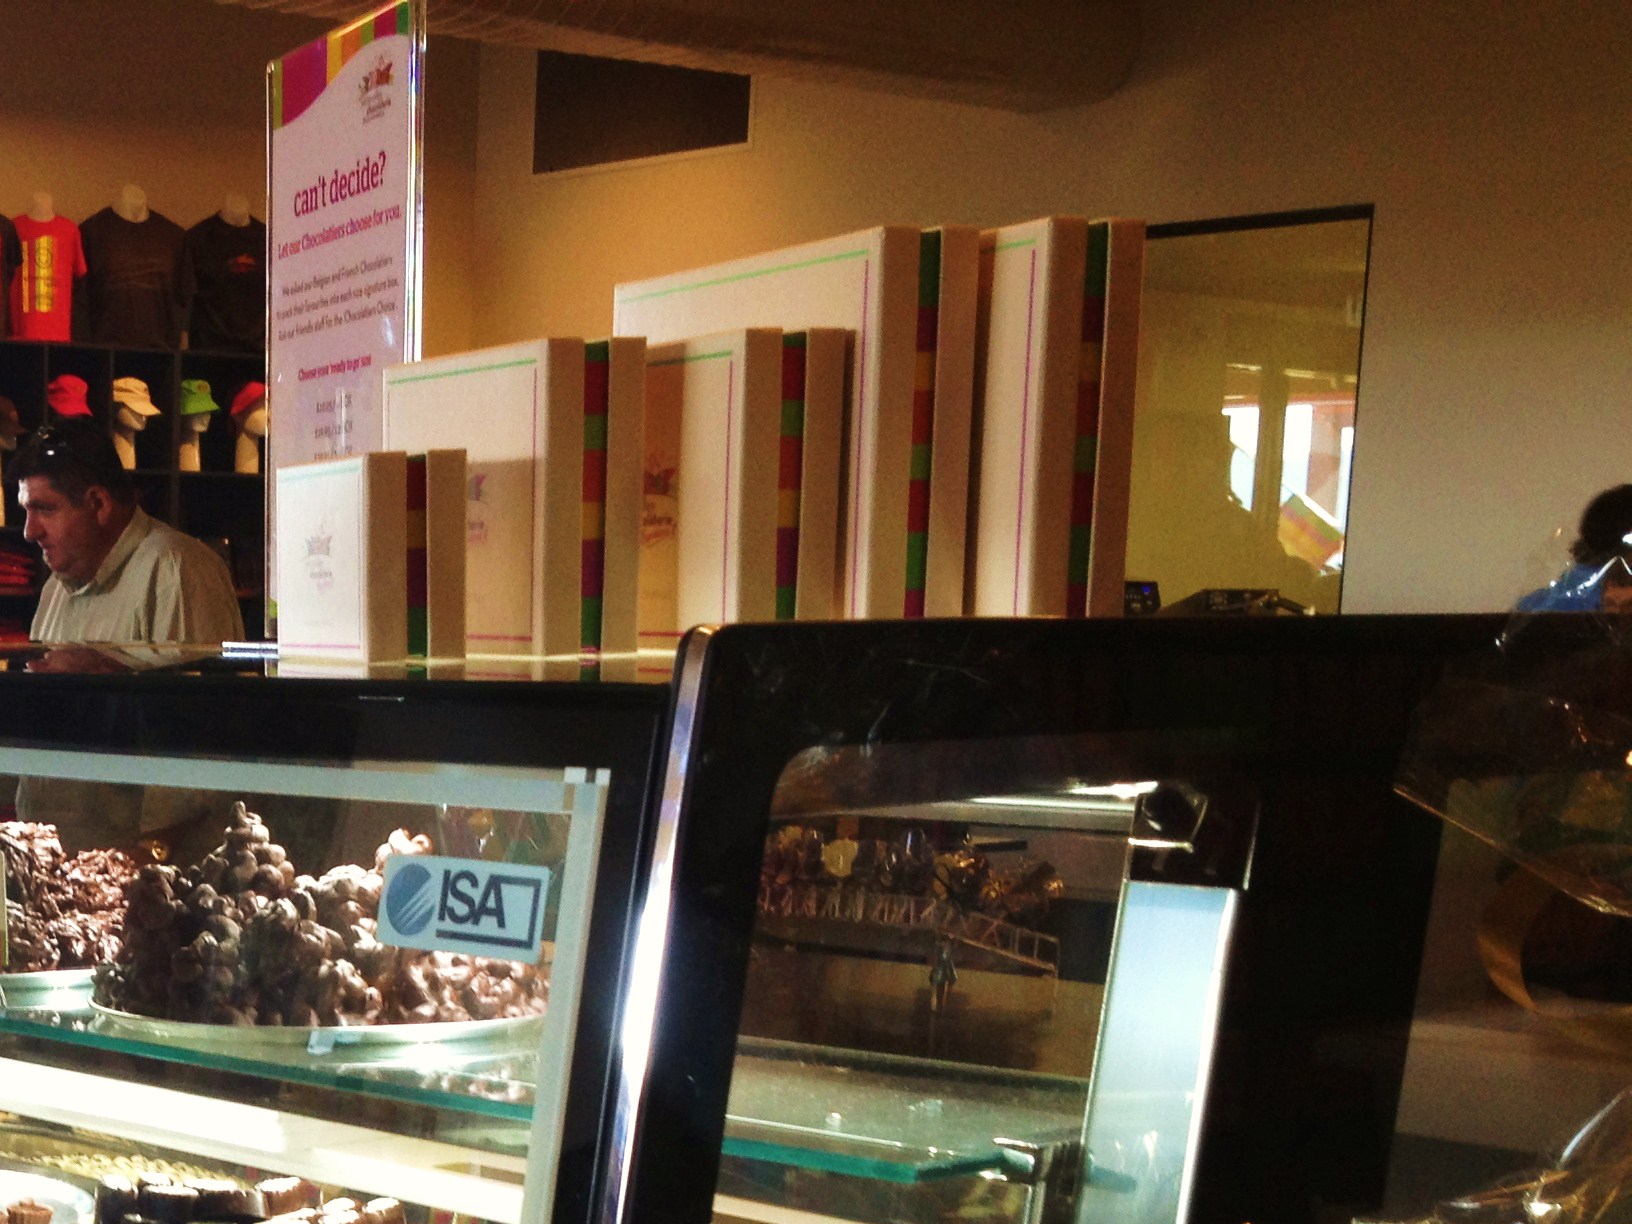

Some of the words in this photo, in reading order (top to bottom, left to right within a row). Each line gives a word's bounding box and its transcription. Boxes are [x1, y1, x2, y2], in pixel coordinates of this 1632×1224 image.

[294, 175, 327, 217] can't
[330, 150, 387, 205] decide?
[346, 217, 372, 236] choose
[437, 868, 506, 929] ISA
